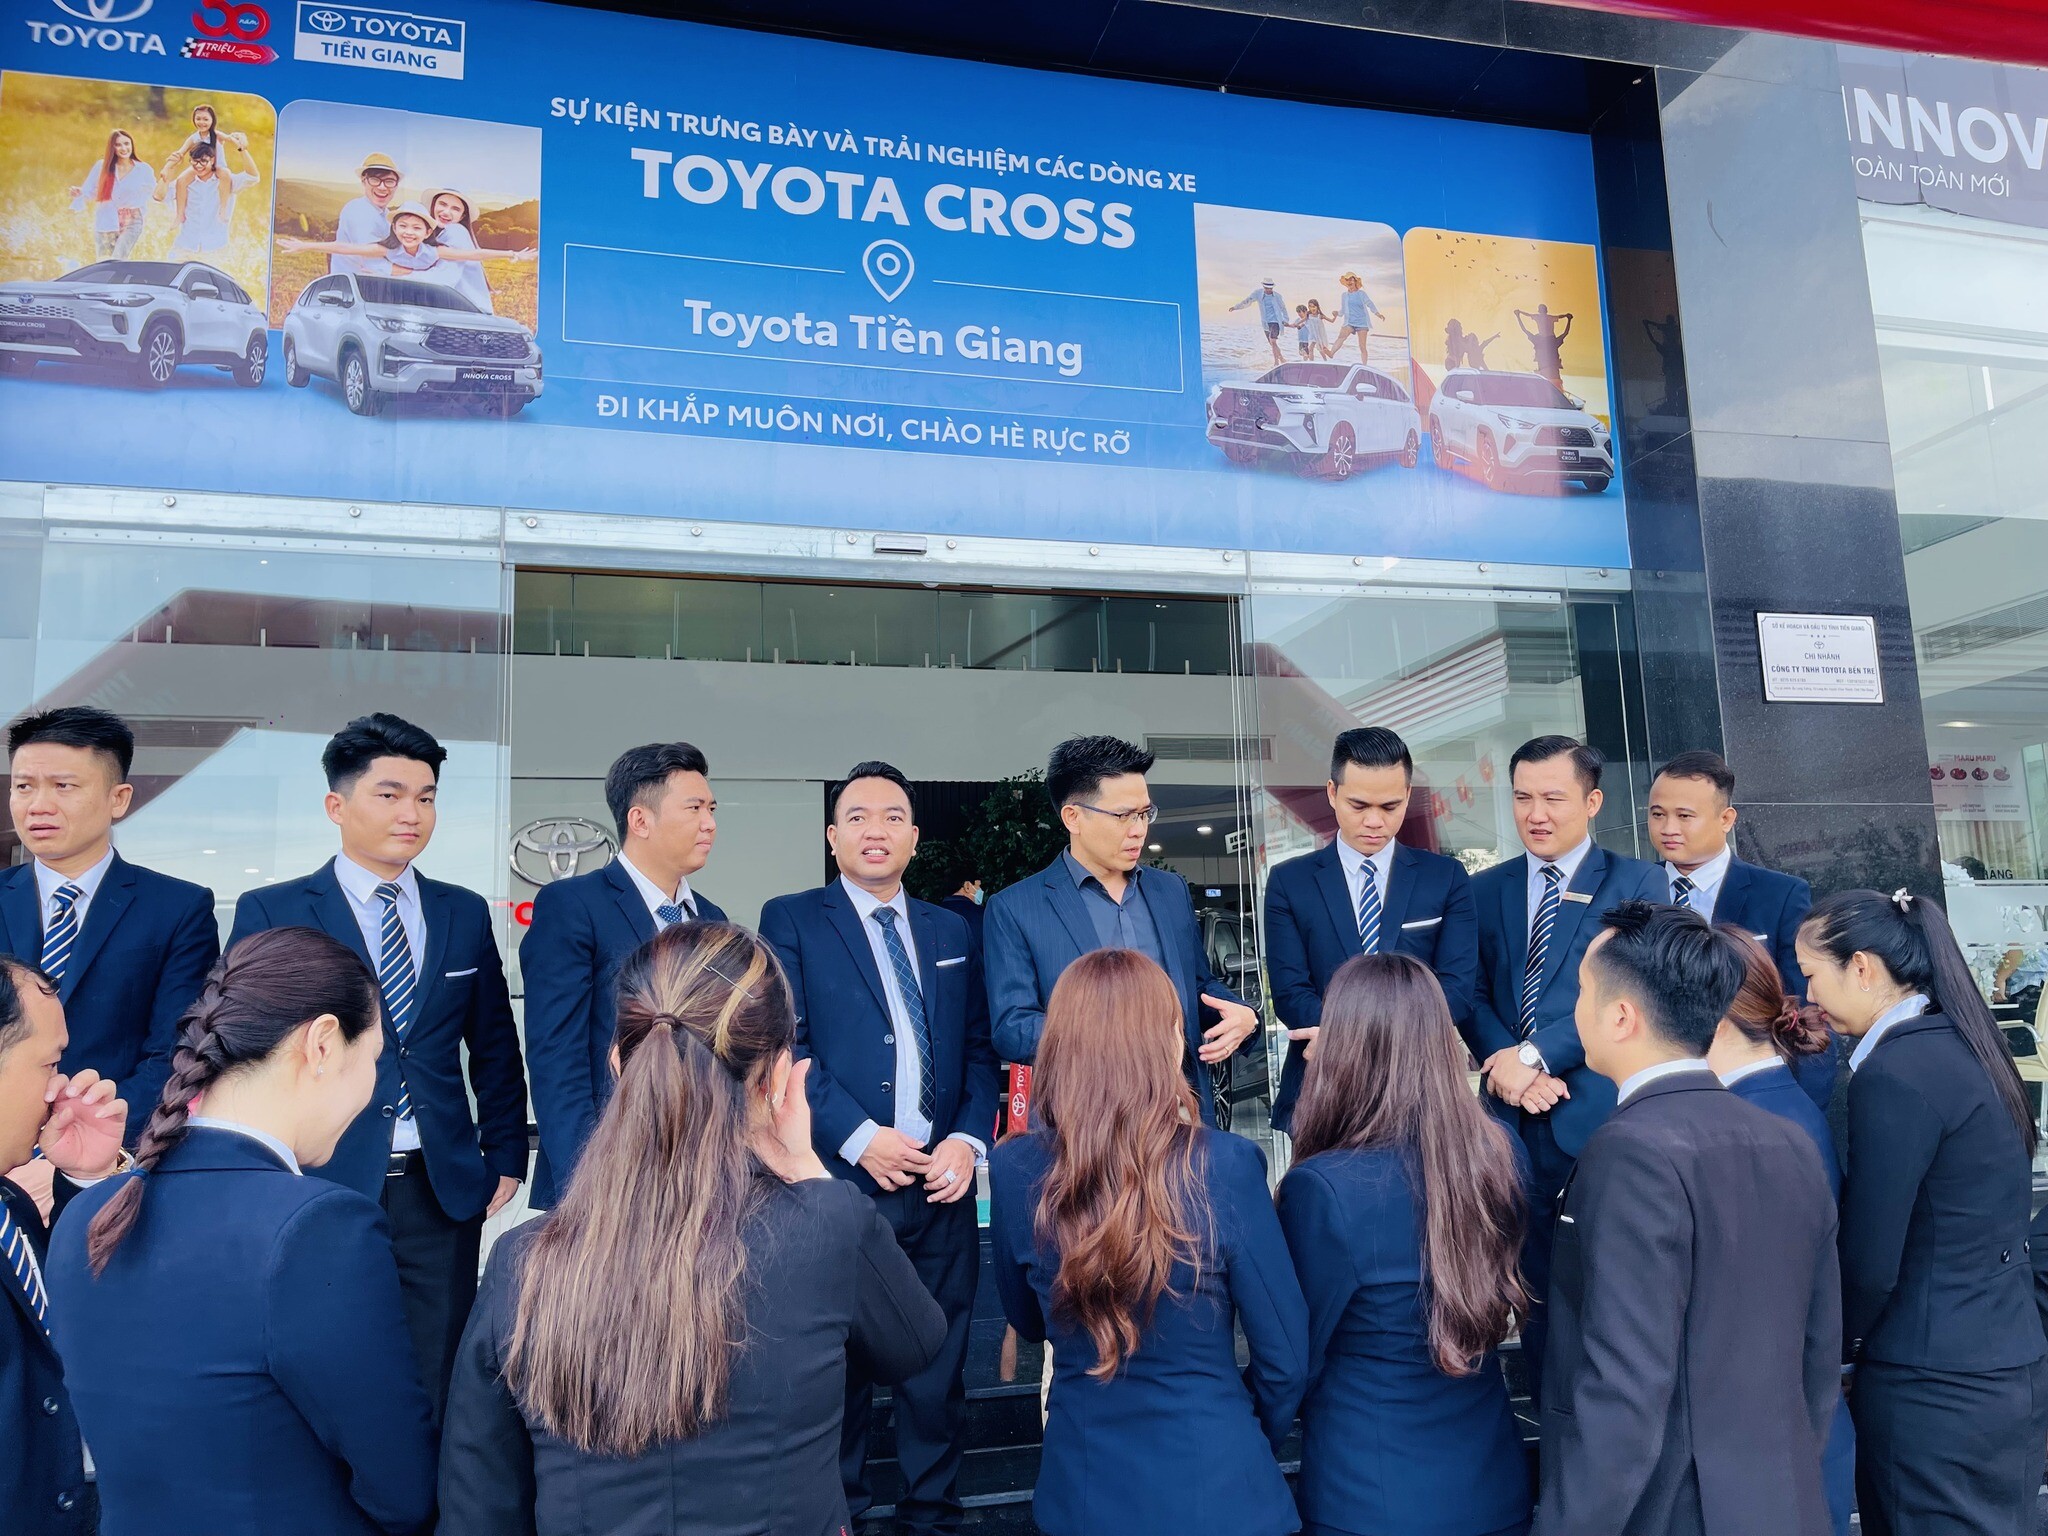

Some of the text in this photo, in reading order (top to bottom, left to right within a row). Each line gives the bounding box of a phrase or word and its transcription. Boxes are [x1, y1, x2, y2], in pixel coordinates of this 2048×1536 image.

[25, 20, 167, 56] TOYOTA
[205, 42, 236, 54] TRIỆU
[350, 16, 453, 46] TOYOTA
[321, 40, 437, 69] TIỀN GIANG
[550, 97, 1197, 193] SỰ KIỆN TRƯNG BÀY VÀ TRẢI NGHIỆM CÁC DÒNG XE
[1841, 85, 2048, 171] NNOV
[1852, 155, 2010, 197] OÀN TOÀN MỚI
[630, 147, 1136, 249] TOYOTA CROSS
[683, 298, 1083, 377] Toyota Tiền Giang
[462, 372, 512, 381] INNOVA CROSS
[596, 392, 1131, 456] ĐI KHẮP MUÔN NƠI, CHÀO HÈ RỰC RỠ
[1771, 663, 1790, 673] CÔNG
[1791, 665, 1800, 673] TY
[1821, 666, 1847, 674] TOYOTA
[1863, 667, 1876, 675] TRE
[1804, 652, 1816, 660] CHI
